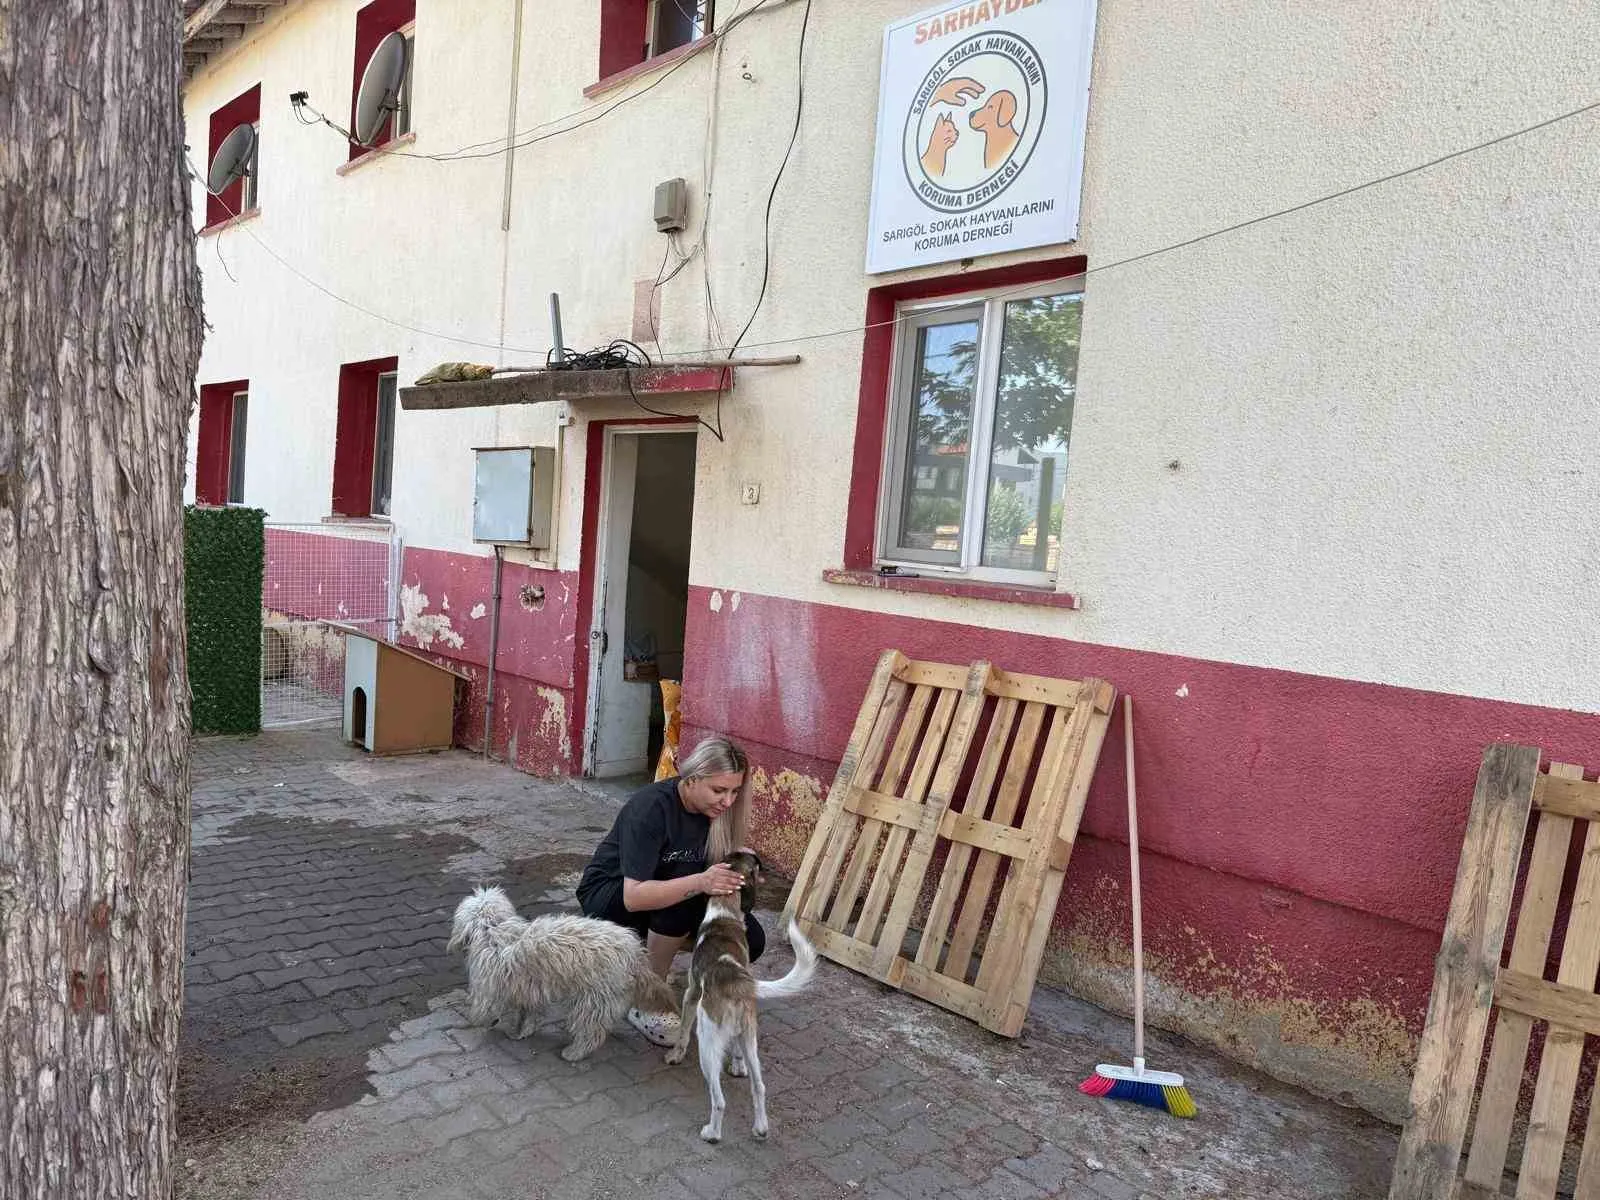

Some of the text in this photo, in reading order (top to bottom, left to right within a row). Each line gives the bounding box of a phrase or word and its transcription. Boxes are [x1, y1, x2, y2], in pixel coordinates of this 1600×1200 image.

[947, 39, 981, 67] SOKAK
[984, 37, 1041, 87] HAYVANLARINI
[918, 180, 963, 207] KORUMA
[929, 216, 967, 234] SOKAK
[970, 199, 1055, 226] HAYVANLARINI
[914, 222, 1013, 252] KORUMA DERNEĞİ
